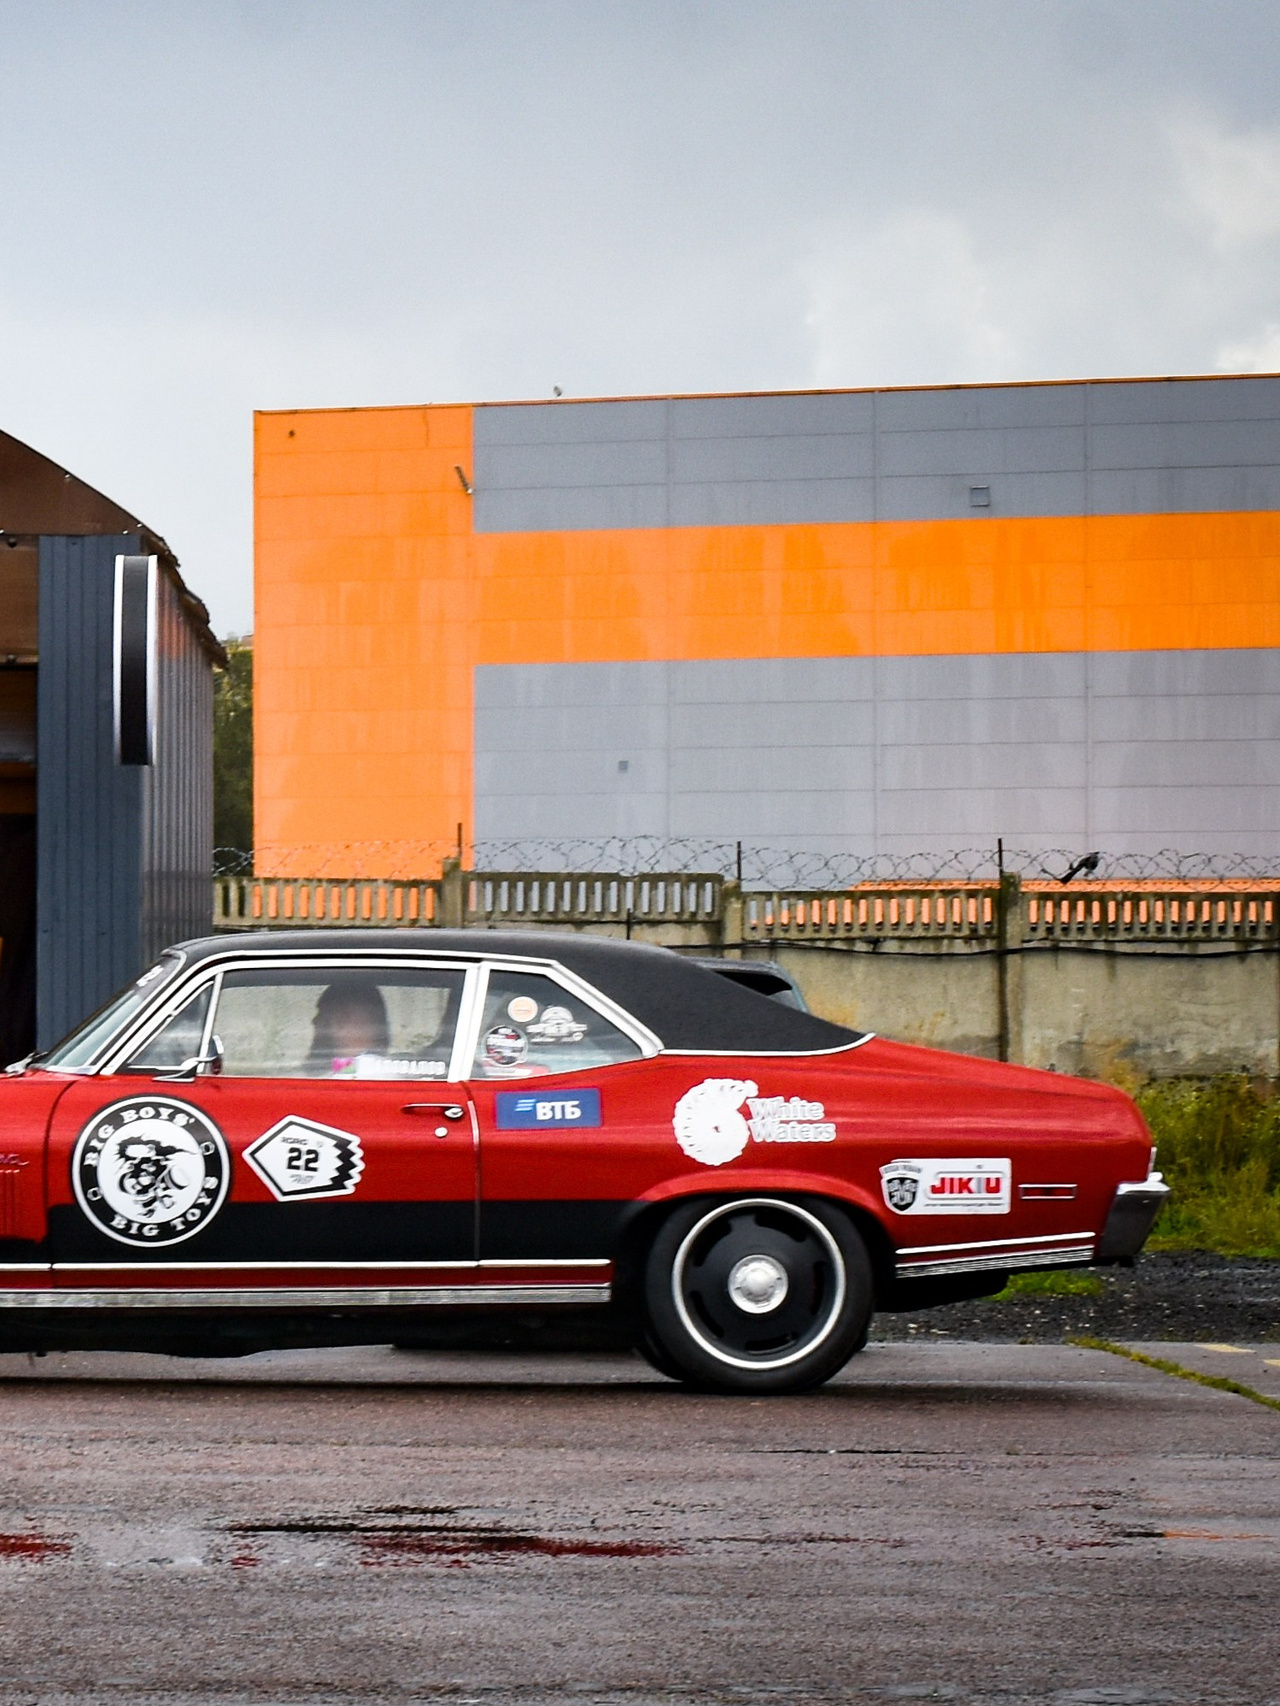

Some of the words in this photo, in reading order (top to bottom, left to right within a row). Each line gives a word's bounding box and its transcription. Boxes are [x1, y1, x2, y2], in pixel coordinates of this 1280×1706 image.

[535, 1100, 582, 1121] ВТБ
[747, 1097, 825, 1119] White
[84, 1123, 115, 1167] BIG
[120, 1106, 195, 1128] BOYS'
[748, 1120, 835, 1142] Waters
[286, 1147, 319, 1172] 22
[110, 1213, 159, 1237] BIG
[170, 1176, 218, 1231] TOYS
